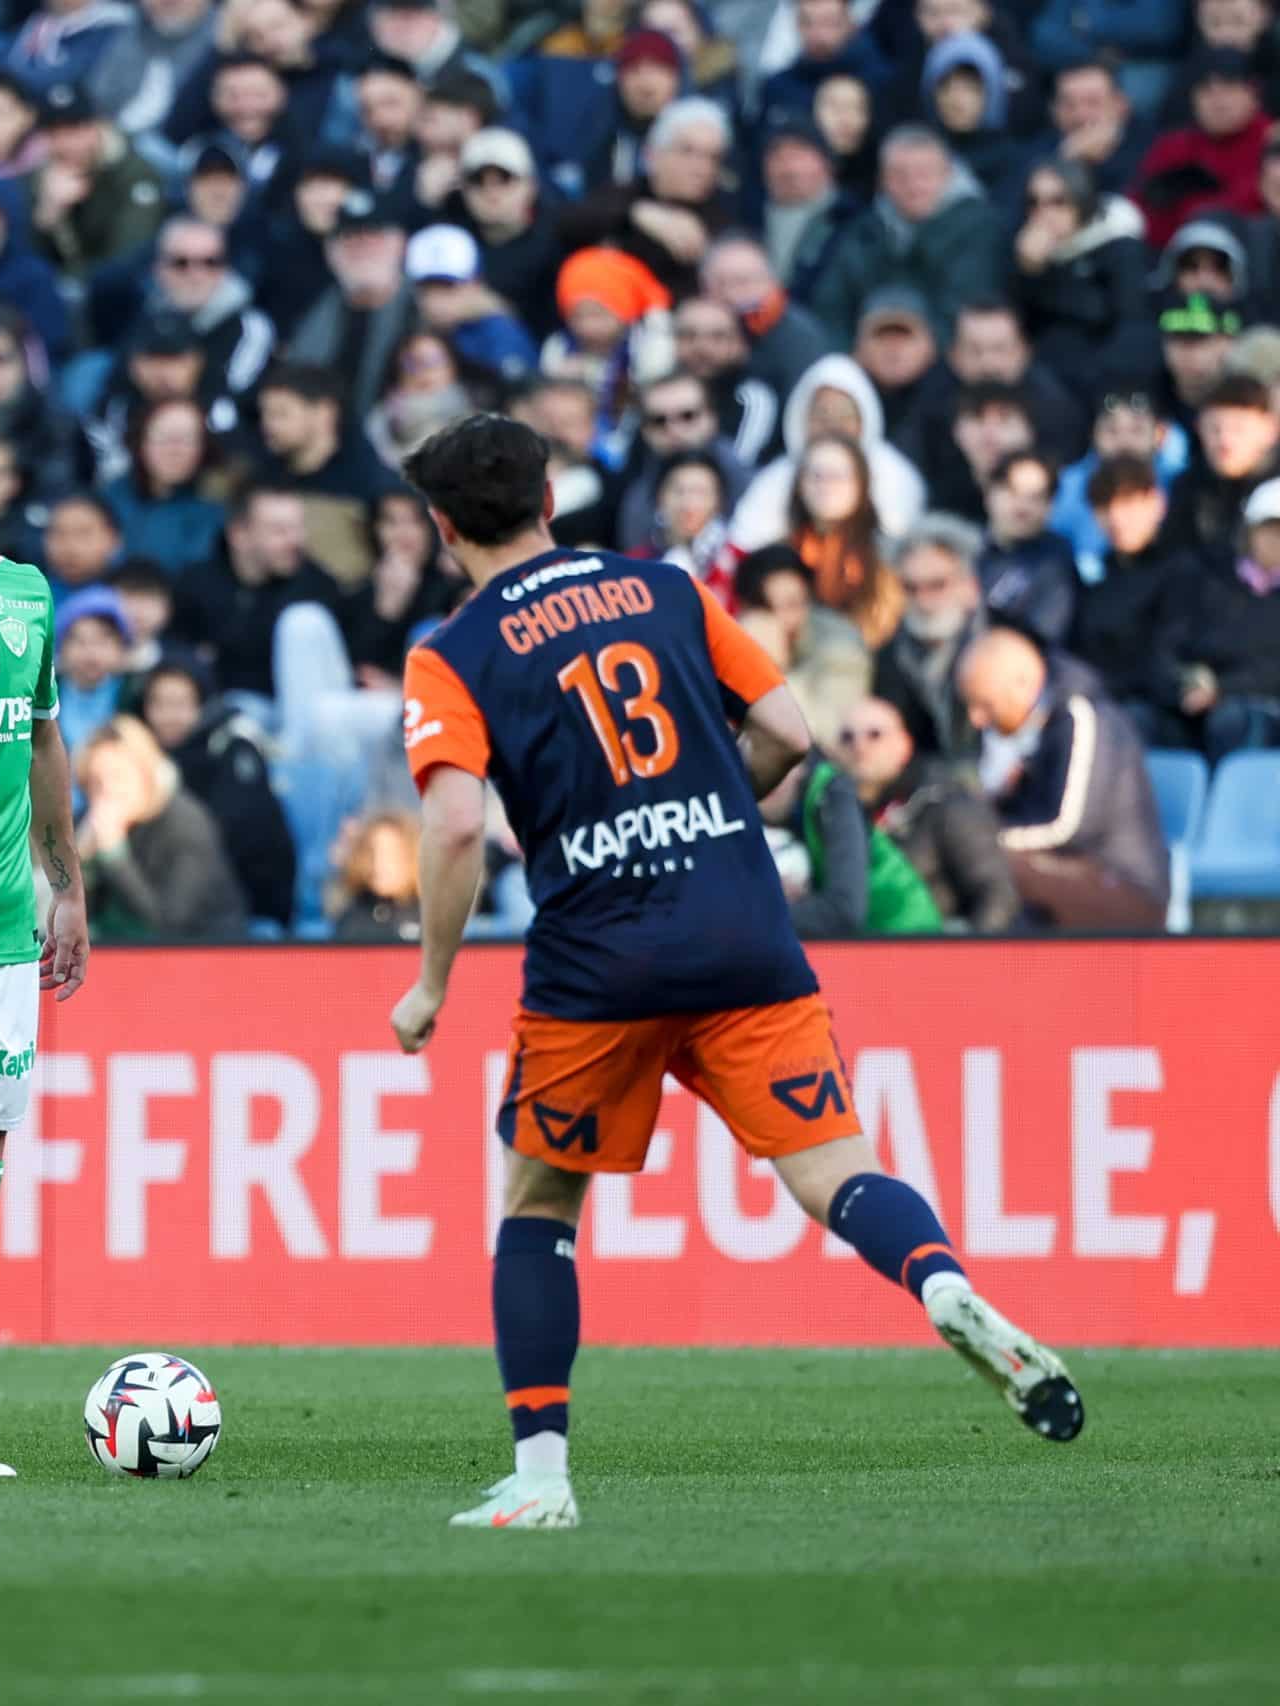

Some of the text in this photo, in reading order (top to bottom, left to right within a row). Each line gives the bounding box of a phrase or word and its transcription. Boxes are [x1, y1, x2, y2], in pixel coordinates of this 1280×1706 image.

[499, 576, 655, 655] CHOTARD
[557, 640, 681, 787] 13
[559, 791, 746, 876] KAPORAL
